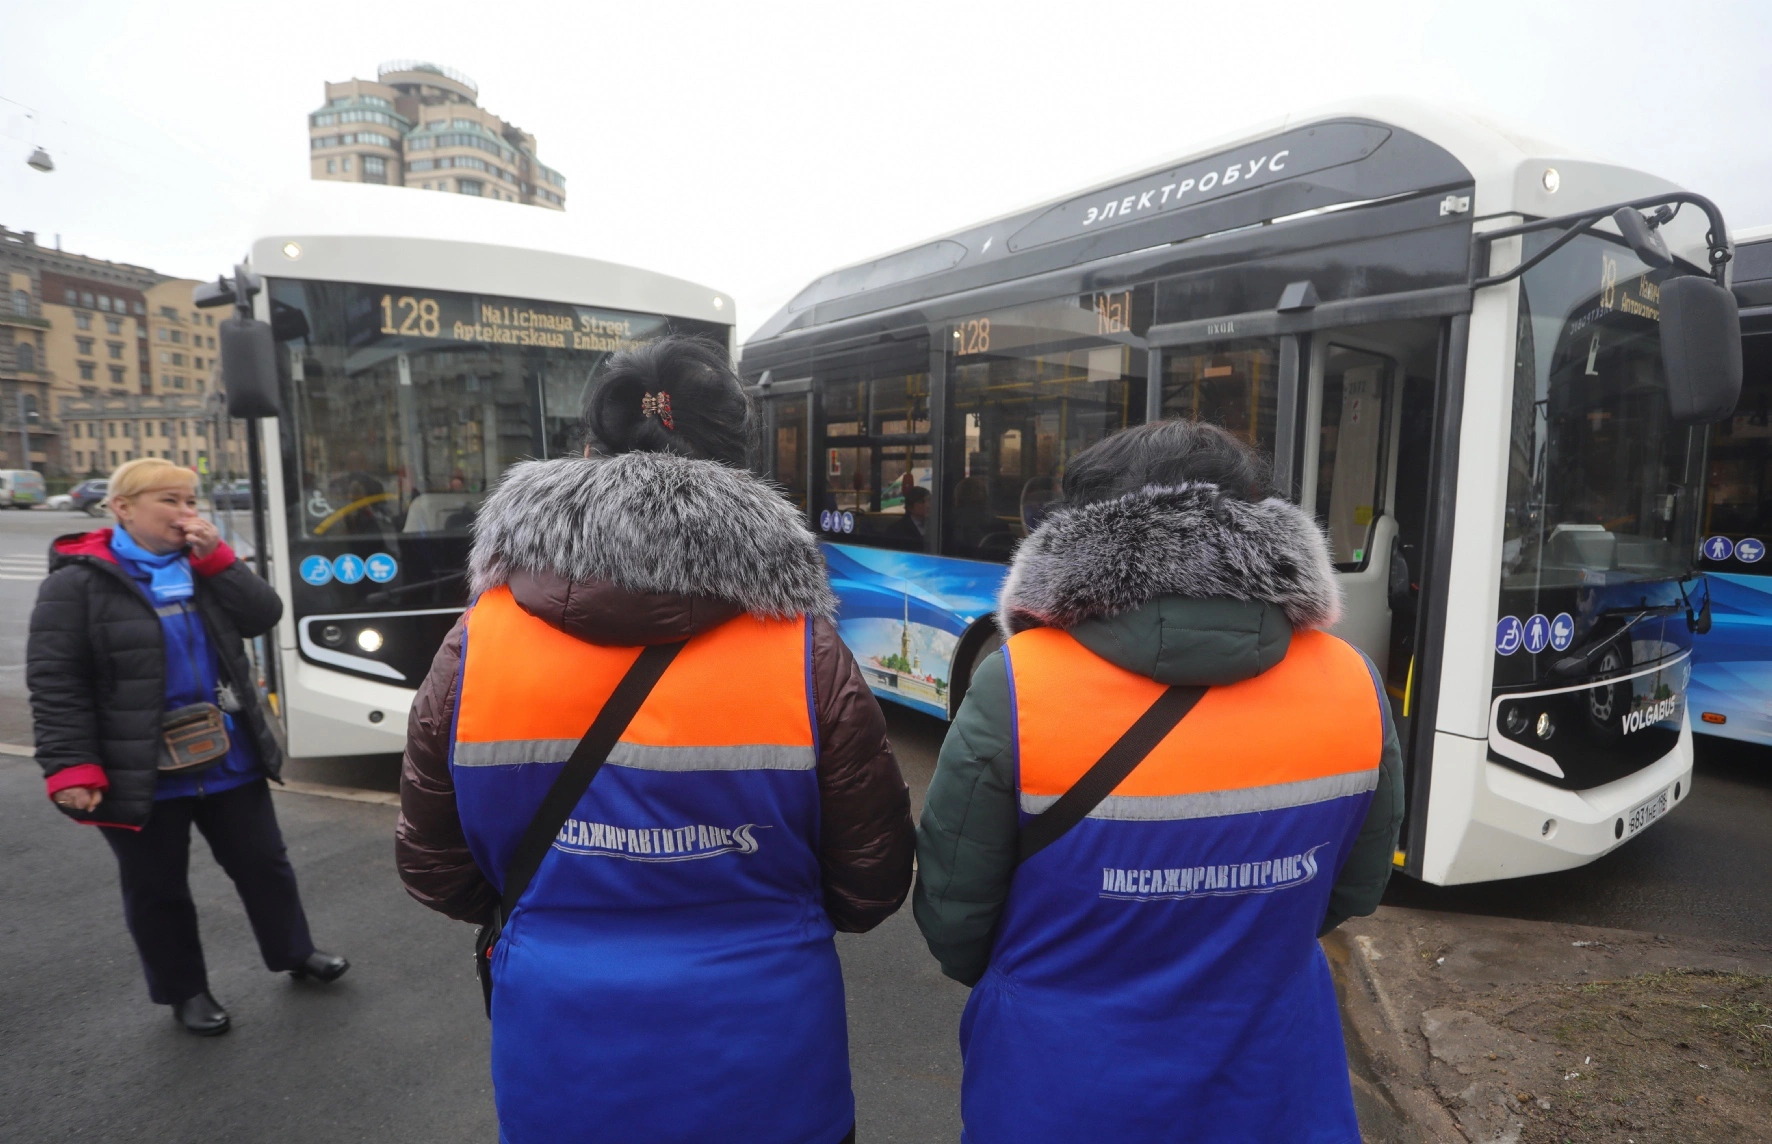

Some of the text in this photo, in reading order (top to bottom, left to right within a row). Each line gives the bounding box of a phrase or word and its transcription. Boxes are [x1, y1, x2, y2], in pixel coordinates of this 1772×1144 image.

[1082, 150, 1290, 226] ЭЛЕКТРОБУС
[380, 294, 441, 337] 128
[453, 320, 566, 348] Aptekarskaya
[481, 304, 631, 336] Nalichnaya Street
[957, 317, 991, 356] 128
[1622, 695, 1676, 735] VOLGABUS
[556, 818, 733, 854] ССАЖИРАВТОТРАНС
[1103, 854, 1302, 893] ПАССАЖИРАВТОТРАНС
